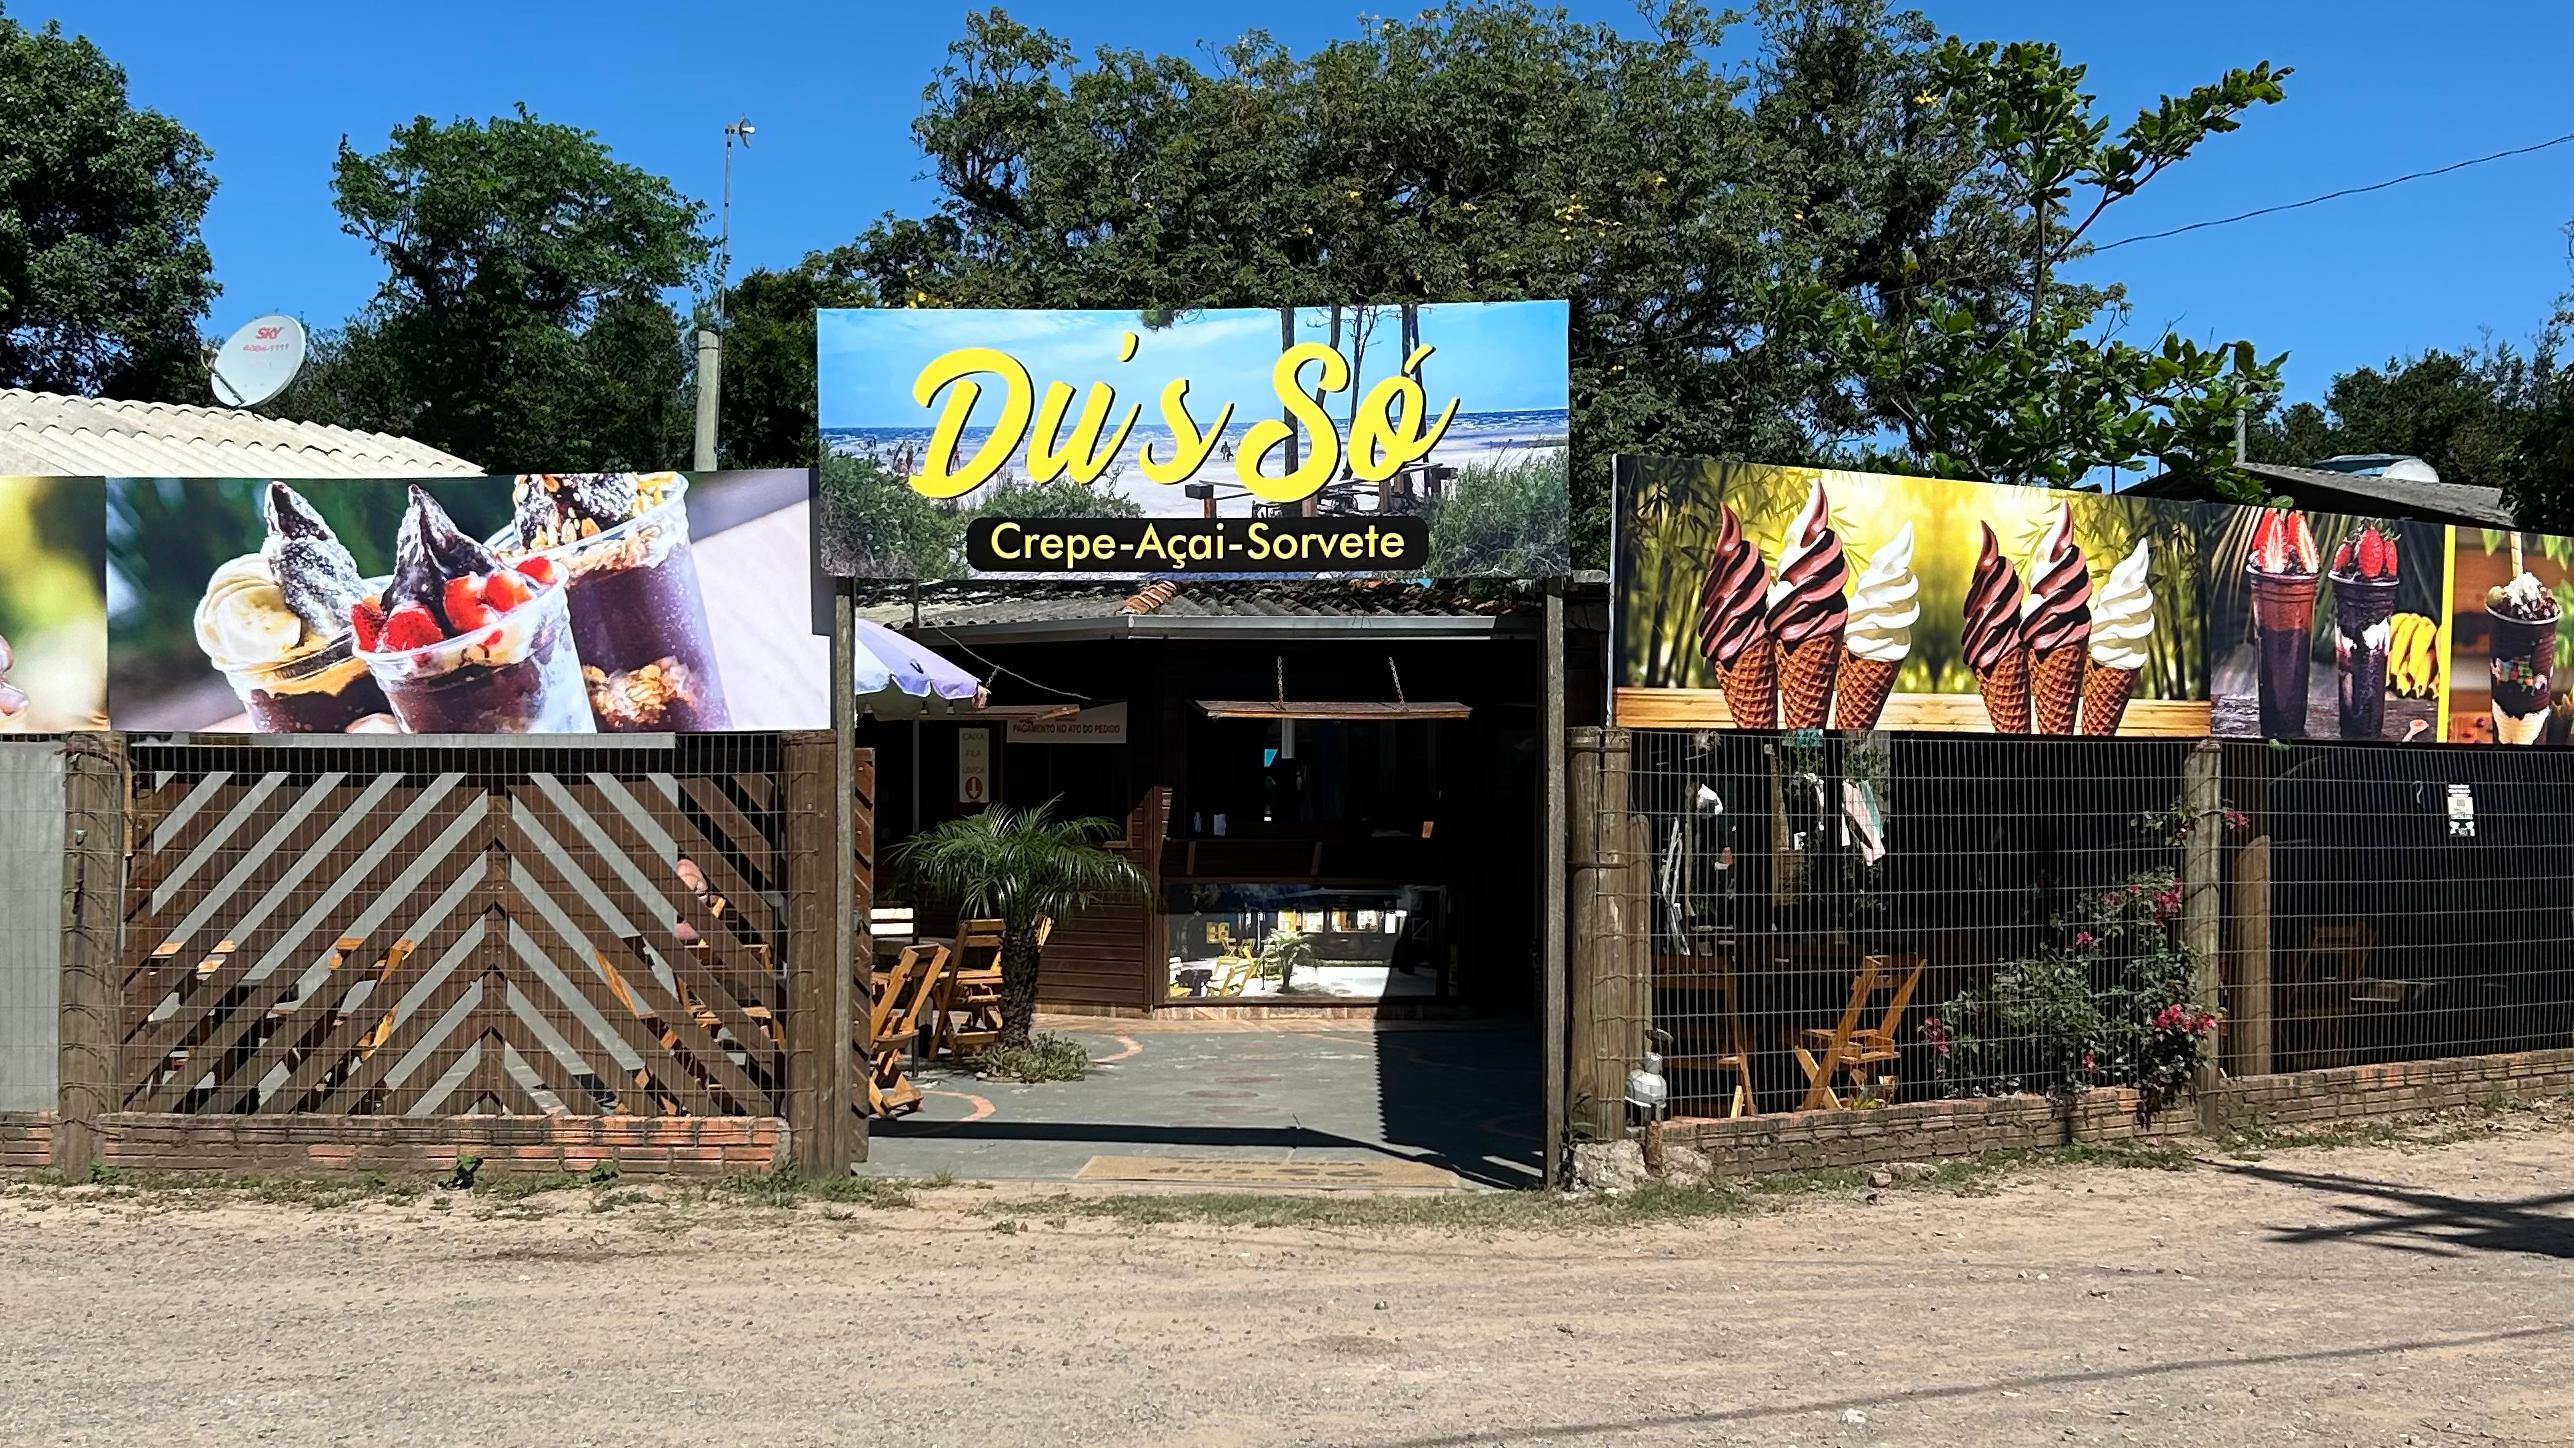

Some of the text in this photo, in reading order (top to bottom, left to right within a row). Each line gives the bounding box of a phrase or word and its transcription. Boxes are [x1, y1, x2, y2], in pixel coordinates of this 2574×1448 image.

[256, 327, 285, 339] SKY
[908, 331, 1460, 503] Du's Só
[990, 521, 1406, 569] Crepe-Açai-Sorvete
[1013, 724, 1120, 734] PAGAMENTO NO ATO DO PEDIDO
